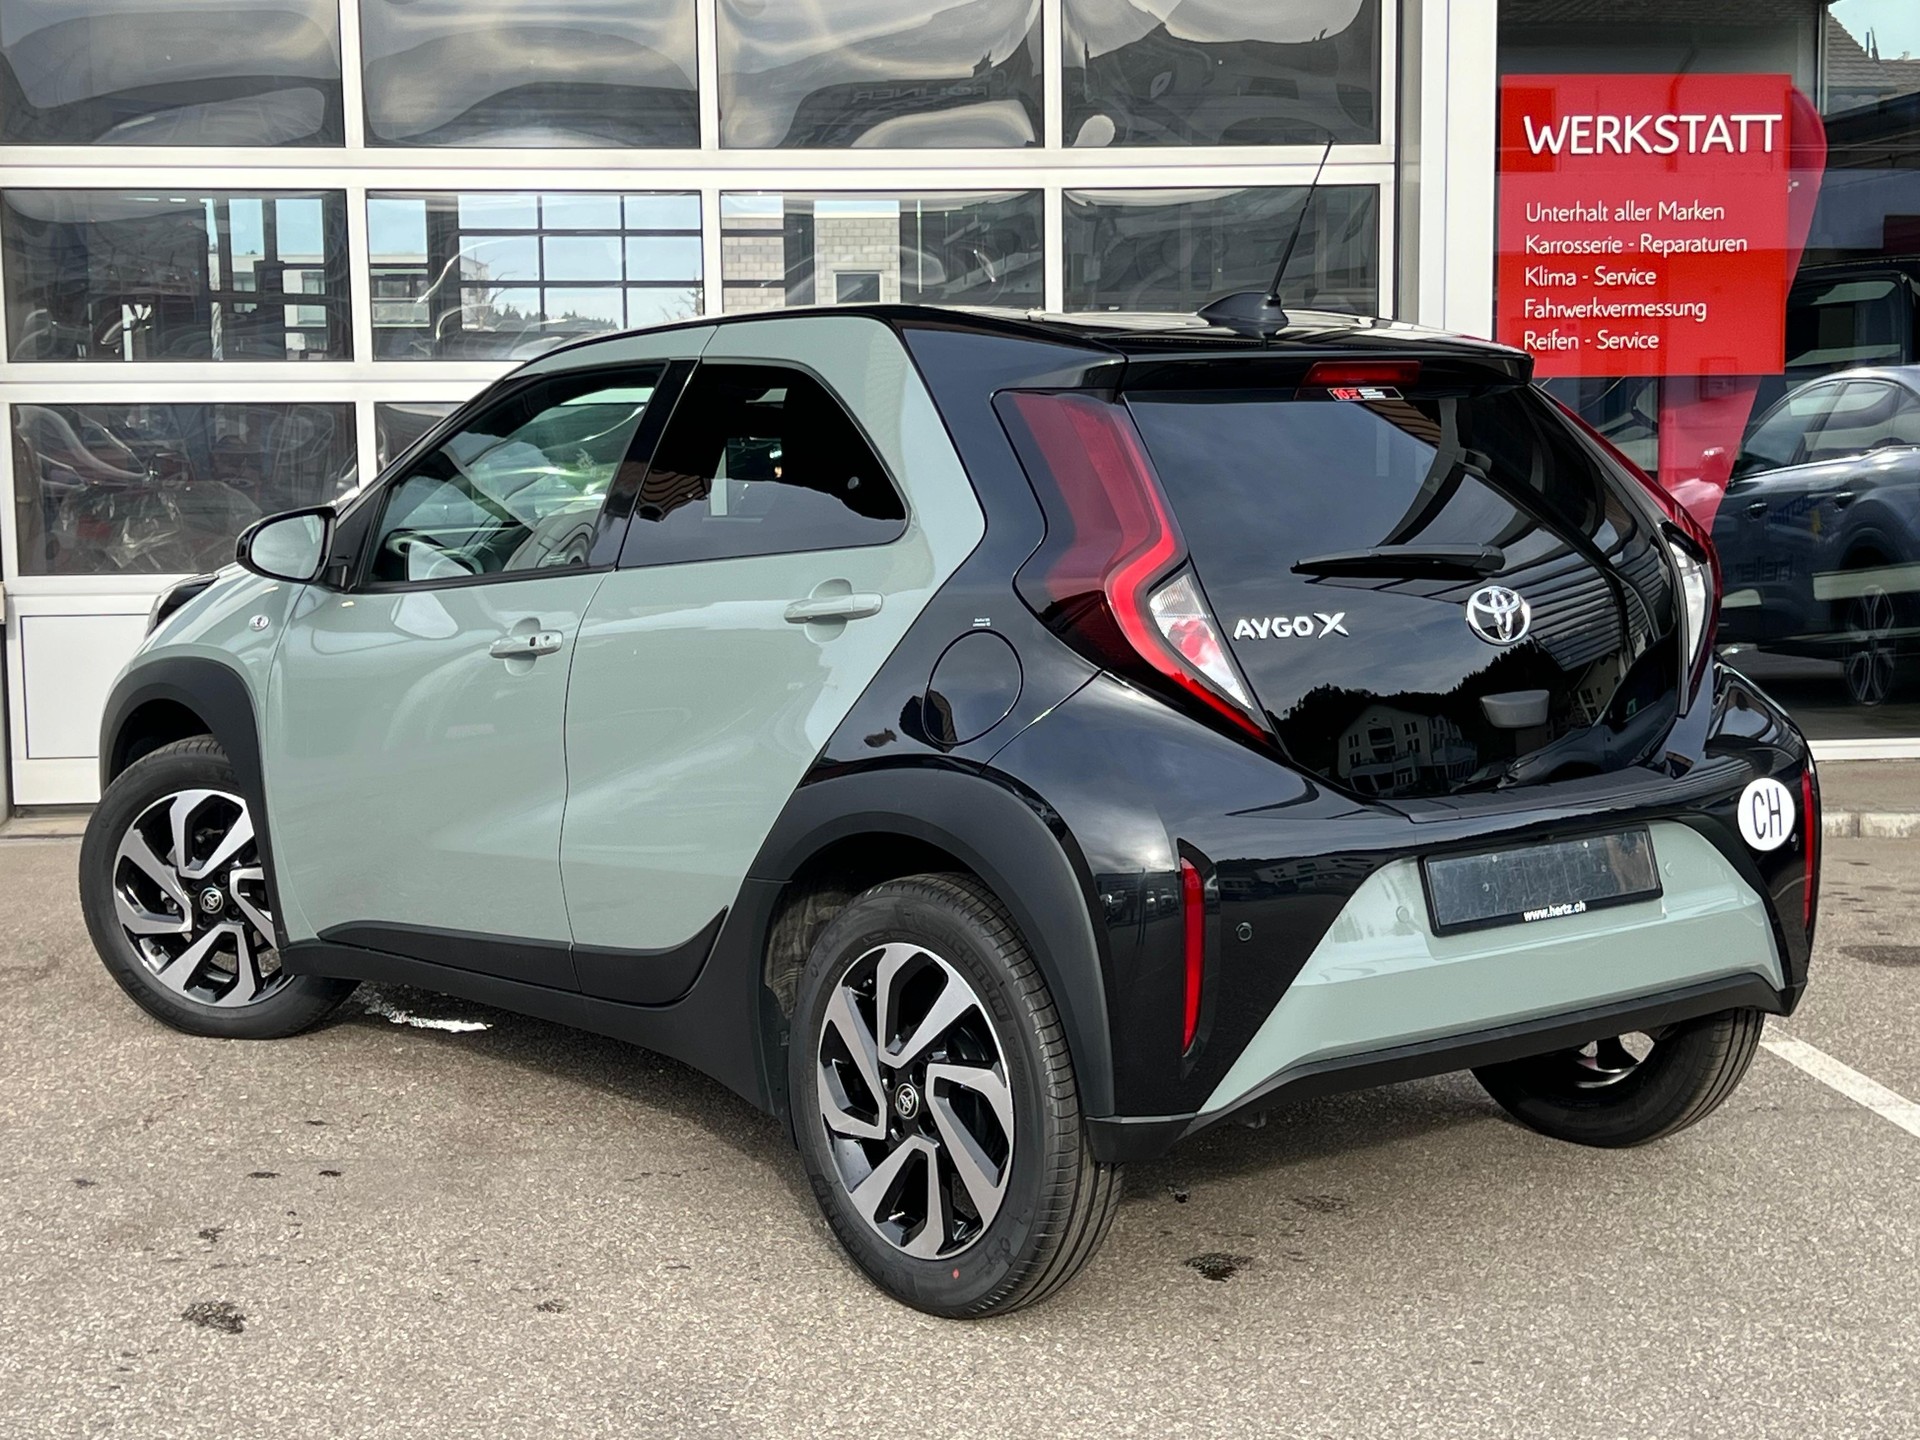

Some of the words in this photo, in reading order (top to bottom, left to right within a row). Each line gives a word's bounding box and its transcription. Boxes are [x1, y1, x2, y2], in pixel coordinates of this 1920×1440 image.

[1524, 115, 1782, 154] WERKSTATT
[1526, 200, 1609, 222] Unterhalt
[1614, 200, 1653, 222] aller
[1658, 199, 1725, 221] Marken
[1526, 234, 1623, 254] Karrosserie
[1640, 233, 1748, 257] Reparaturen
[1525, 266, 1577, 286] Klima
[1594, 265, 1657, 286] Service
[1525, 297, 1707, 321] Fahrwerkvermessung
[1524, 328, 1579, 350] Reifen
[1596, 329, 1659, 350] Service
[1752, 787, 1782, 839] CH
[1523, 900, 1586, 921] www.hertz.ch
